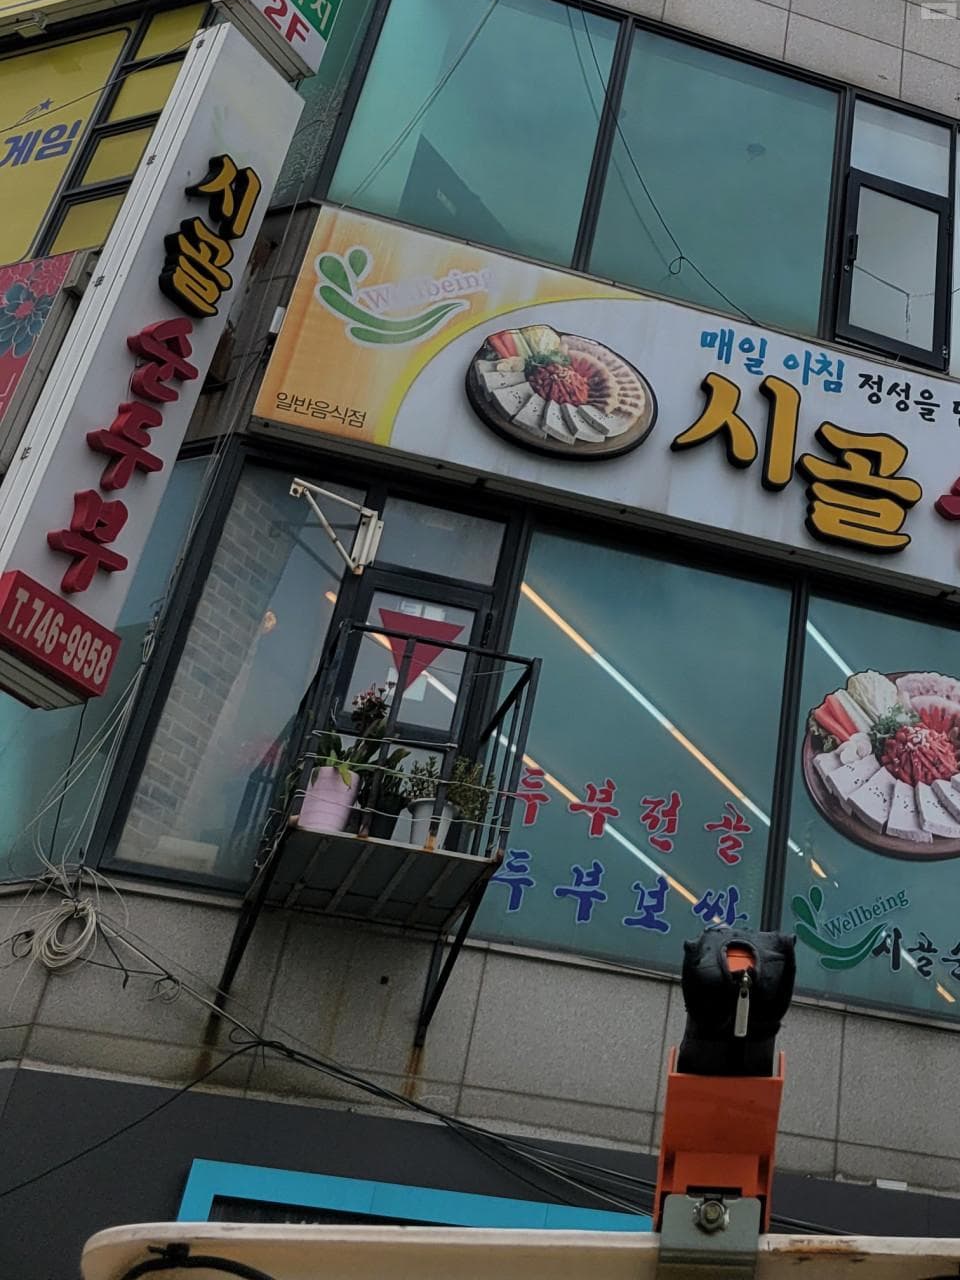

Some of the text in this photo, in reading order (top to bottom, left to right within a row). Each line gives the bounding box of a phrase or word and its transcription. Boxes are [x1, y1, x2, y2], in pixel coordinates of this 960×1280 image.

[0, 120, 81, 168] 게임
[364, 271, 495, 309] Wbeing
[699, 328, 768, 376] 매일
[783, 349, 846, 394] 아침
[858, 371, 941, 422] 정성을
[275, 392, 367, 429] 일반음식점
[8, 589, 113, 686] T.746-9958
[515, 766, 752, 866] 두부전골
[823, 889, 910, 939] Wellbeing
